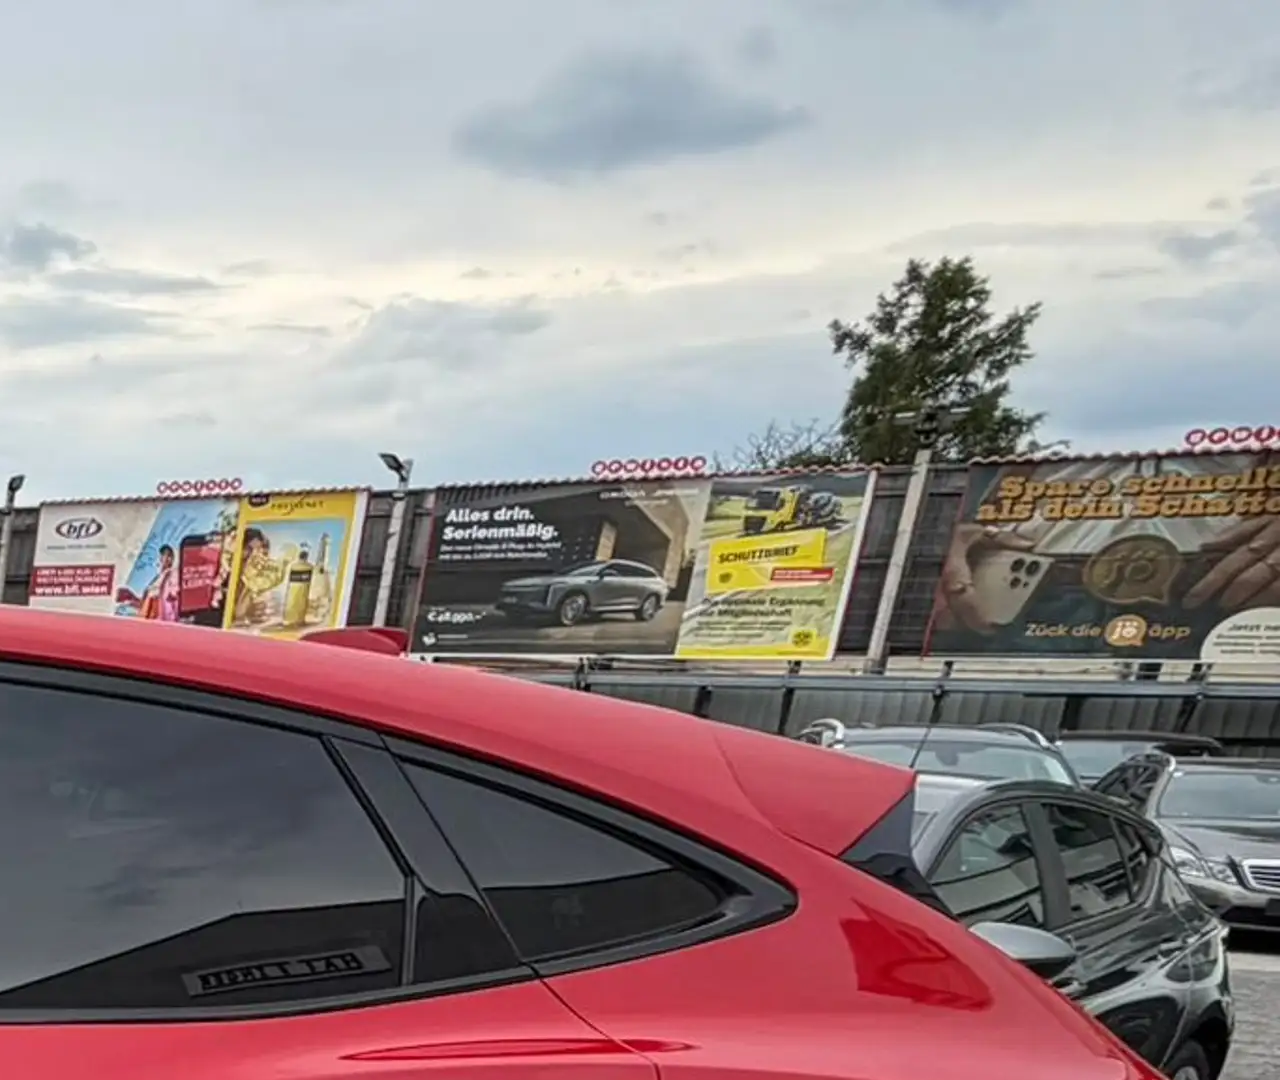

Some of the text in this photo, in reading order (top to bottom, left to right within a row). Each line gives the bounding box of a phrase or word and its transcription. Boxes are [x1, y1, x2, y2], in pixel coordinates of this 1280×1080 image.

[998, 475, 1113, 499] Spare
[445, 506, 534, 522] Alles drin.
[975, 501, 1033, 521] als
[1043, 499, 1123, 520] dein
[442, 523, 558, 540] Serienmäßig.
[717, 545, 801, 564] SCHUTZBRIEF
[1025, 621, 1068, 638] Zück
[1072, 622, 1101, 638] die
